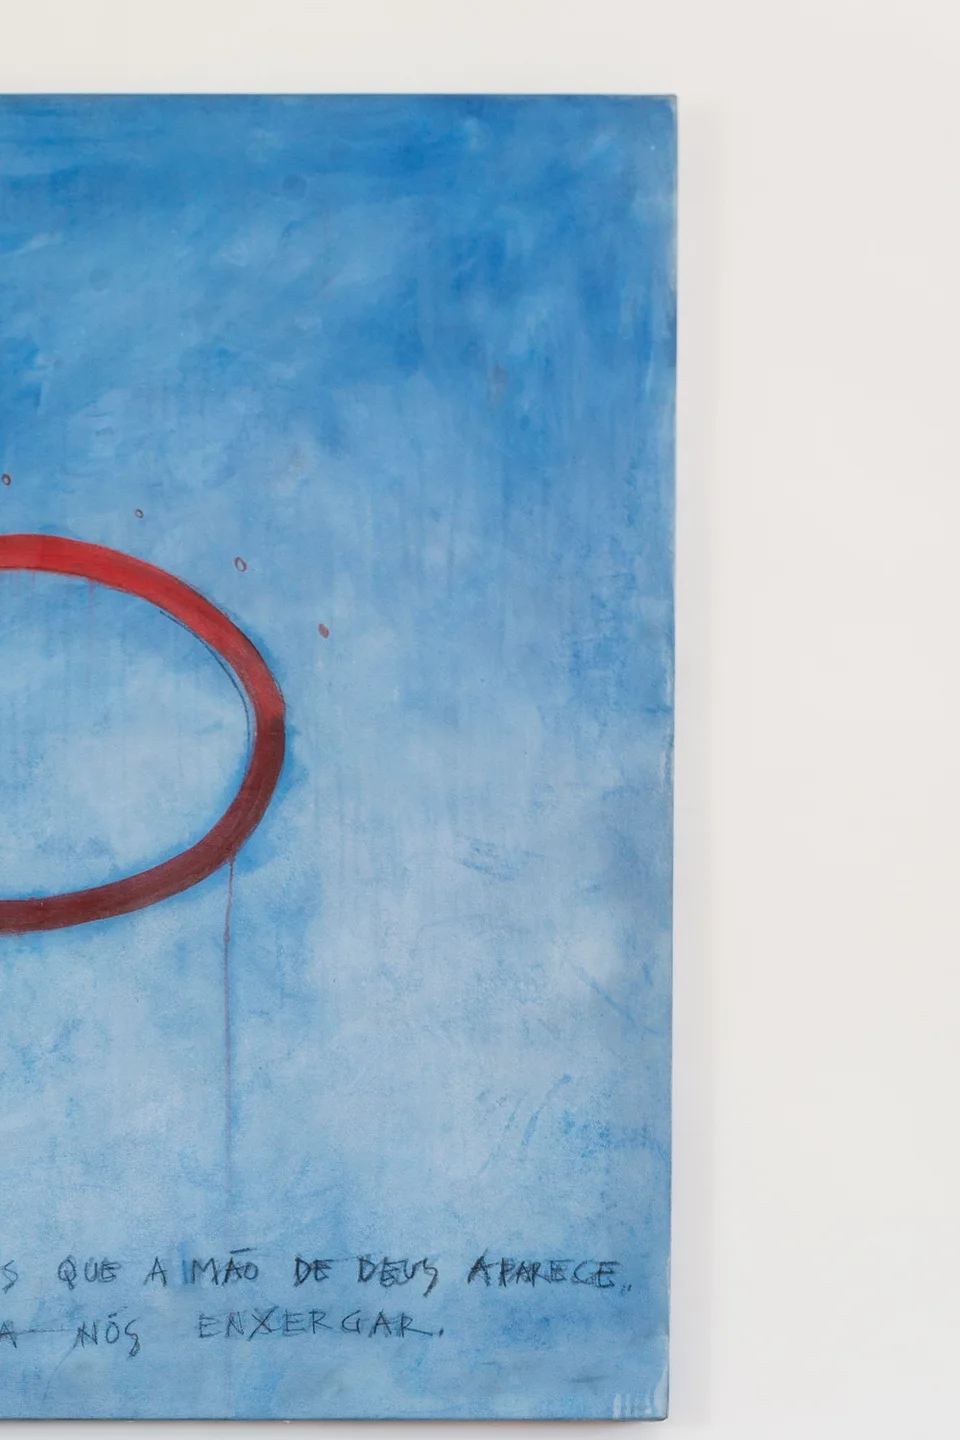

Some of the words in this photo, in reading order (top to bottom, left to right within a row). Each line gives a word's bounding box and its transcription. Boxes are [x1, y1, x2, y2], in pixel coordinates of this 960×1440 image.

[57, 1254, 122, 1290] QUE
[143, 1256, 168, 1287] A
[190, 1247, 259, 1286] MÃO
[293, 1254, 335, 1286] DE
[357, 1252, 440, 1297] DEUS
